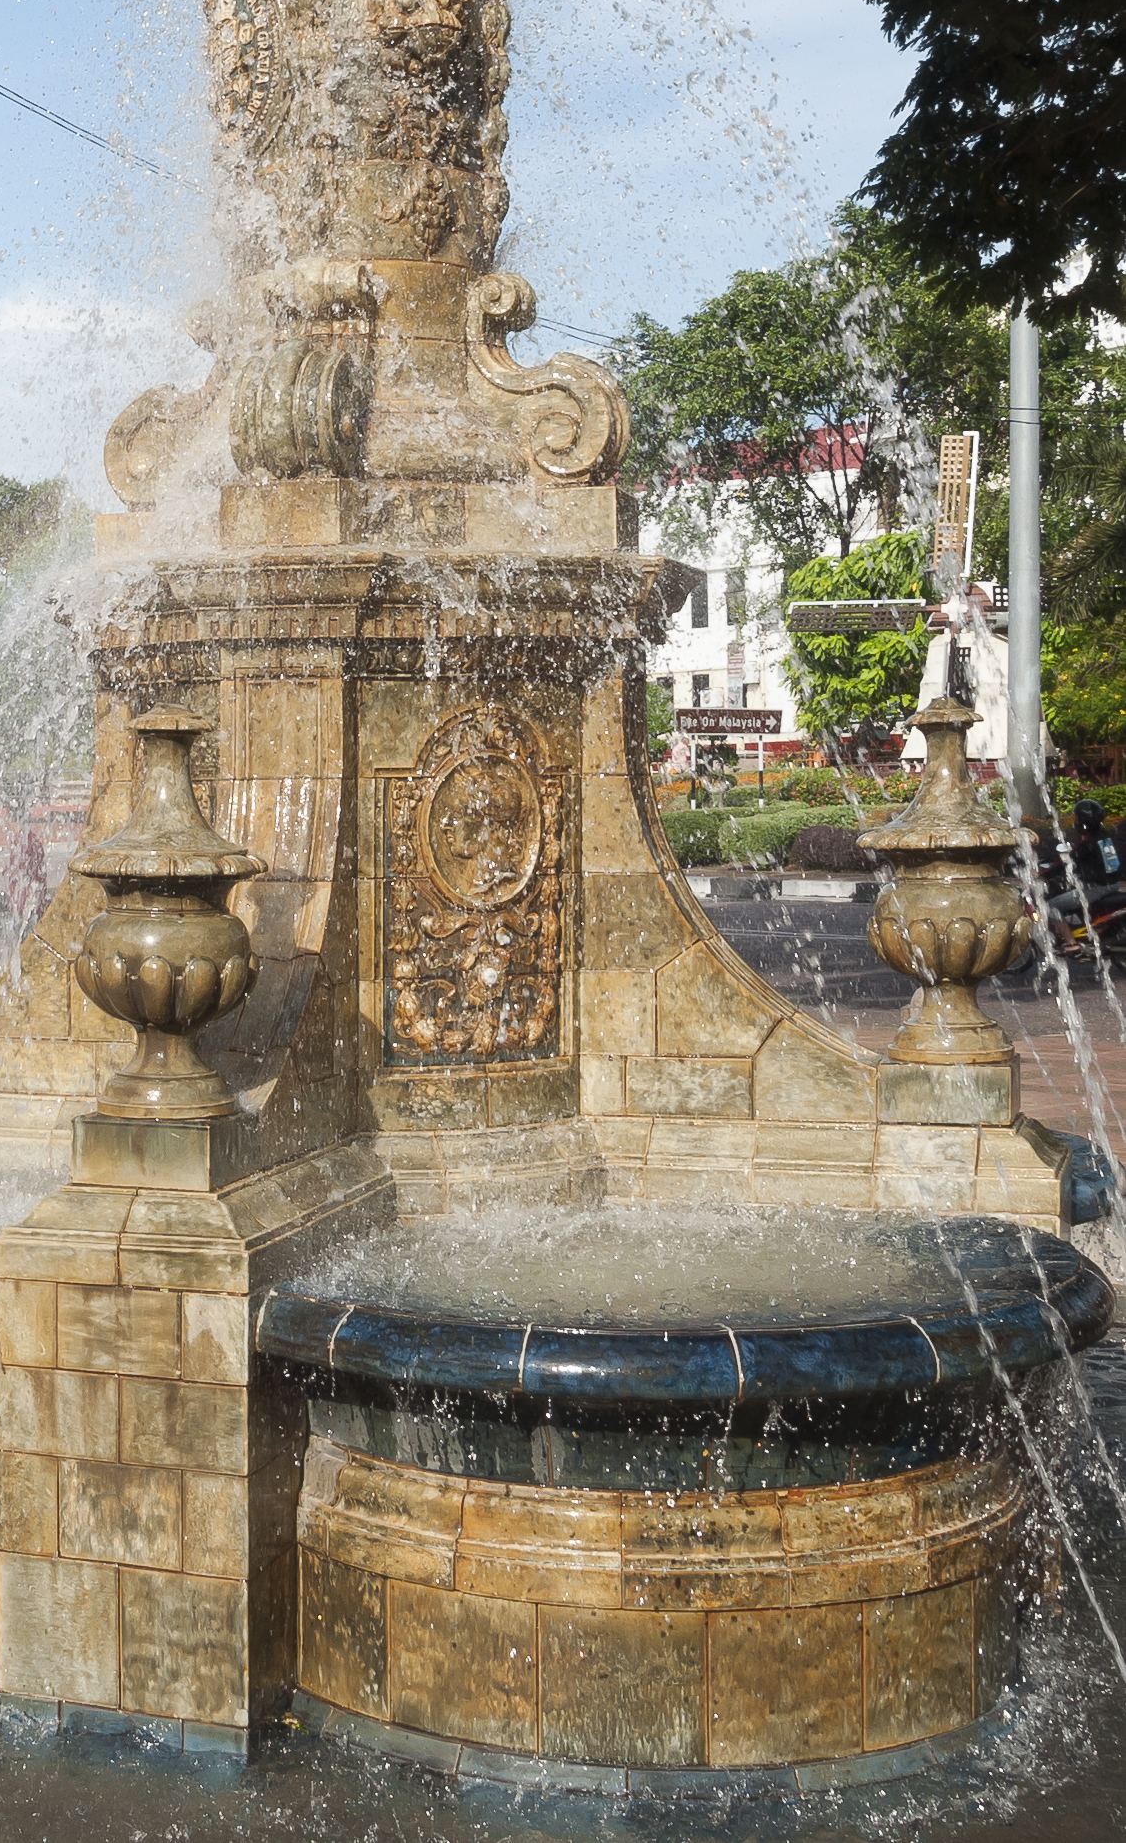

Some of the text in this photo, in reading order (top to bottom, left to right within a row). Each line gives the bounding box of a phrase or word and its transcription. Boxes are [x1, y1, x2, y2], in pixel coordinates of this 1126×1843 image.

[680, 715, 761, 729] Eye On Malaysia
